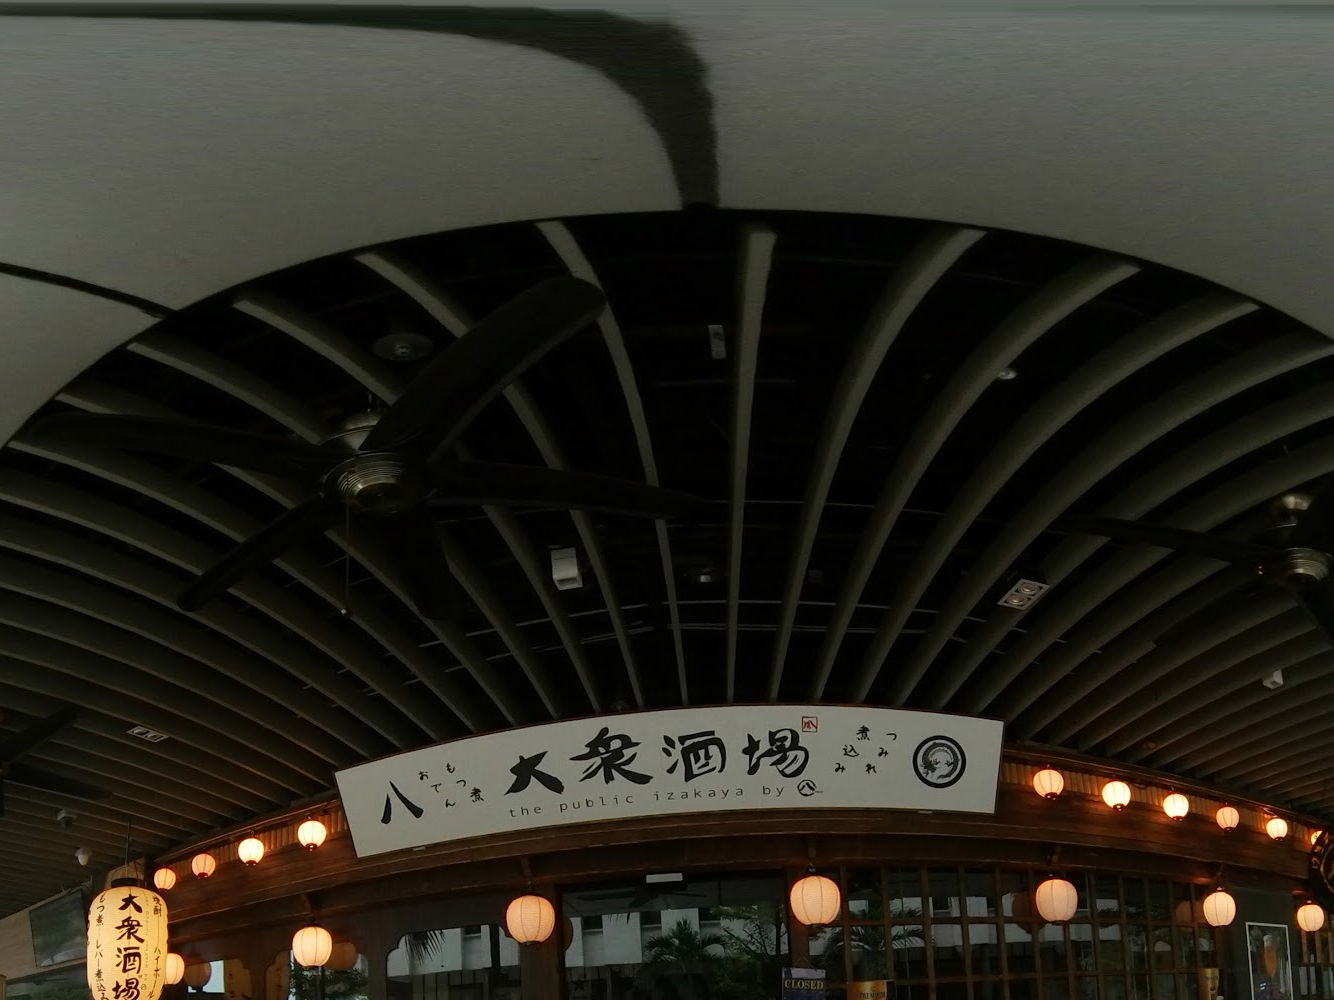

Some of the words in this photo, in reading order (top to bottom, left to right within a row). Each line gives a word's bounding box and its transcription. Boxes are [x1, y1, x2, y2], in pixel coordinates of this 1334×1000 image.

[503, 726, 809, 795] 大衆酒場
[418, 770, 456, 808] おでん
[445, 762, 484, 803] もつ煮
[509, 804, 542, 818] the
[559, 794, 634, 813] public
[653, 786, 745, 800] izakaya
[762, 784, 784, 796] by
[784, 979, 824, 990] CLOSED
